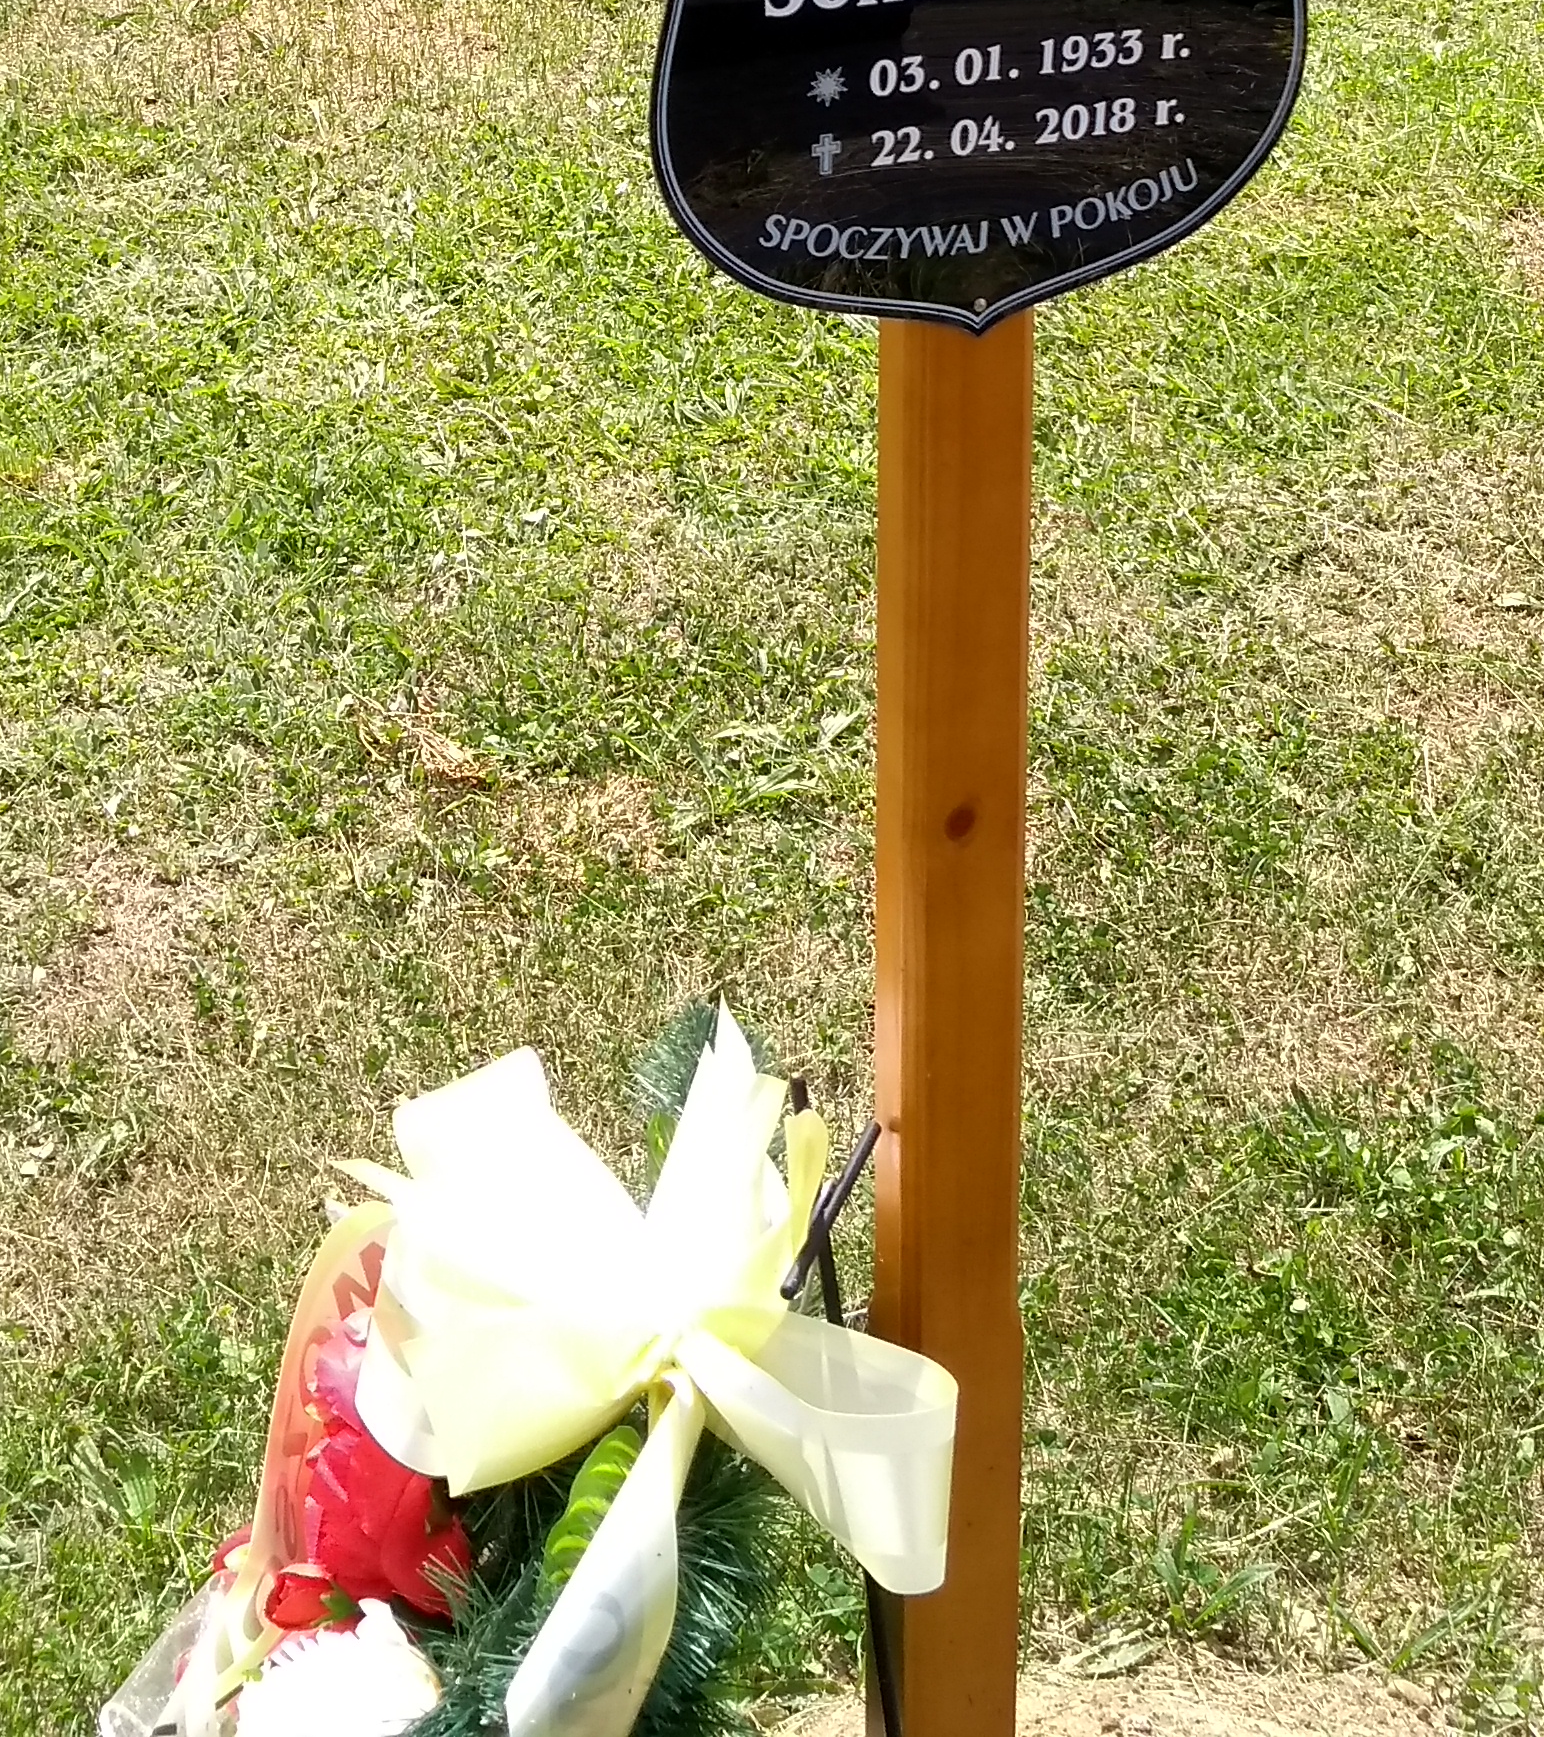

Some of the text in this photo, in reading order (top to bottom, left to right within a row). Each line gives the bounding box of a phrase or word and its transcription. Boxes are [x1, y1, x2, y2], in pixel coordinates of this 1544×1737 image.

[869, 28, 1190, 97] 03. 01. 1933 r.
[870, 97, 1185, 167] 22. 04. 2018 r.
[759, 158, 1198, 260] SPOCZYWAJ W POKOJU
